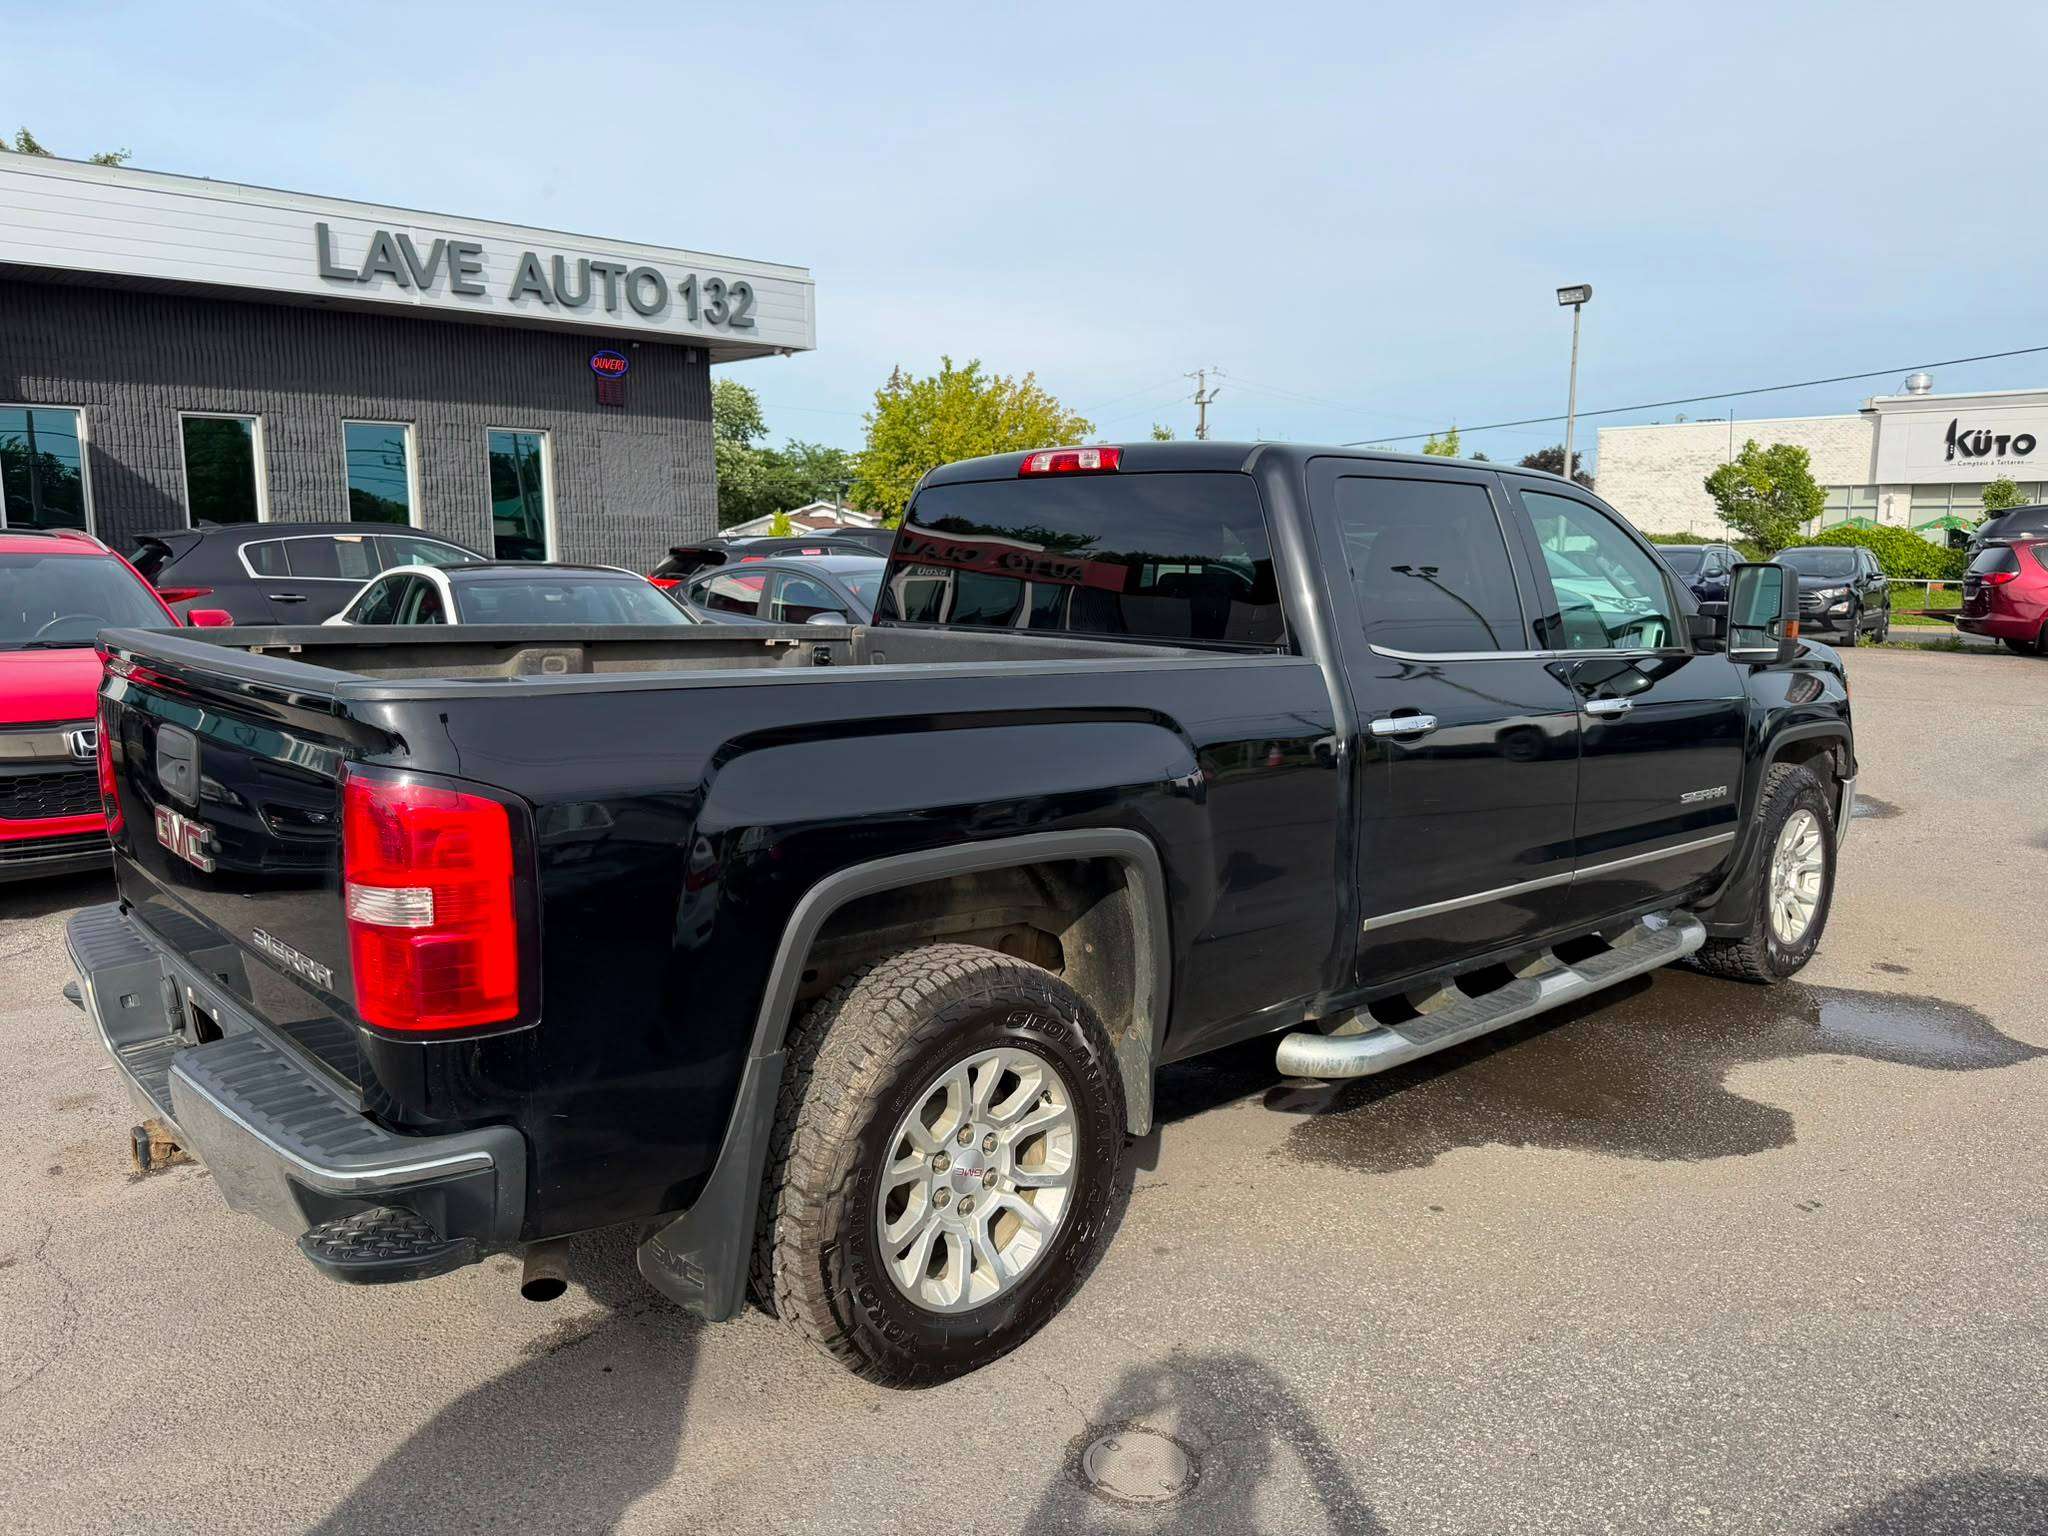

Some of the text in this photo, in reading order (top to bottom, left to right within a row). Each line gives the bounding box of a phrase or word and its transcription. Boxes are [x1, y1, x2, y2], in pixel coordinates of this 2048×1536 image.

[315, 222, 755, 328] LAVE AUTO 132
[593, 357, 625, 371] OUVERT
[1680, 785, 1727, 803] SIERRA
[154, 804, 216, 873] GMC
[252, 926, 336, 991] SIERRA
[954, 1167, 984, 1177] GMC
